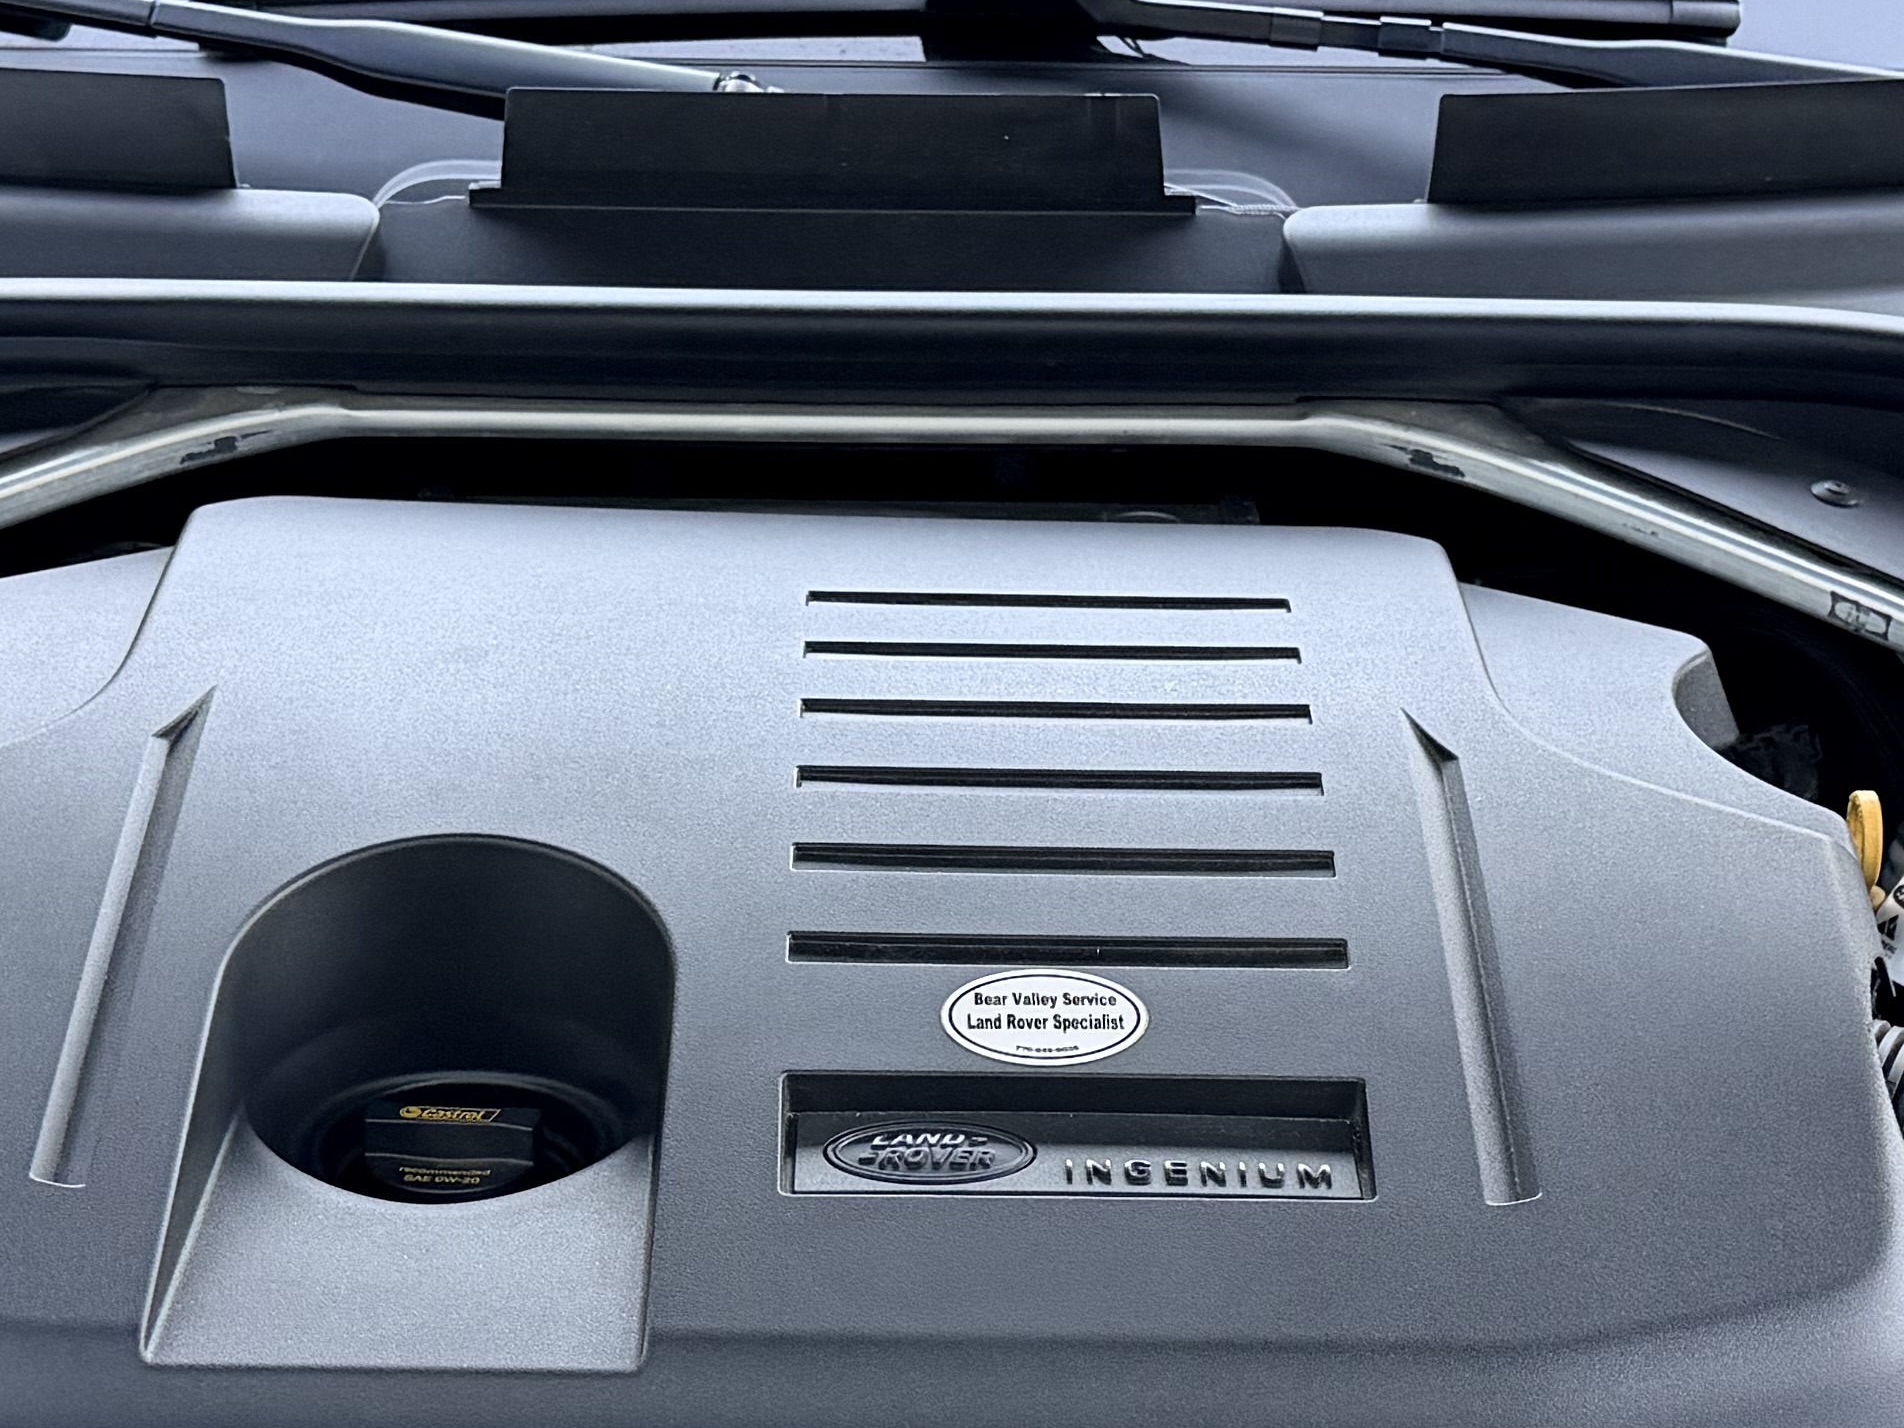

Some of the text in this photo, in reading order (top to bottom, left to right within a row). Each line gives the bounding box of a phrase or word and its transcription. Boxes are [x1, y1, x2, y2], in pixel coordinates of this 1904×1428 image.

[973, 992, 1117, 1009] Bear Valley Service
[967, 1013, 1125, 1033] Land Rover Specialist
[421, 1108, 485, 1122] Castrol
[870, 1132, 966, 1150] LAND
[876, 1146, 996, 1171] ROVER
[403, 1174, 480, 1184] SAE 0W-20
[1064, 1158, 1333, 1189] INGENIUM
